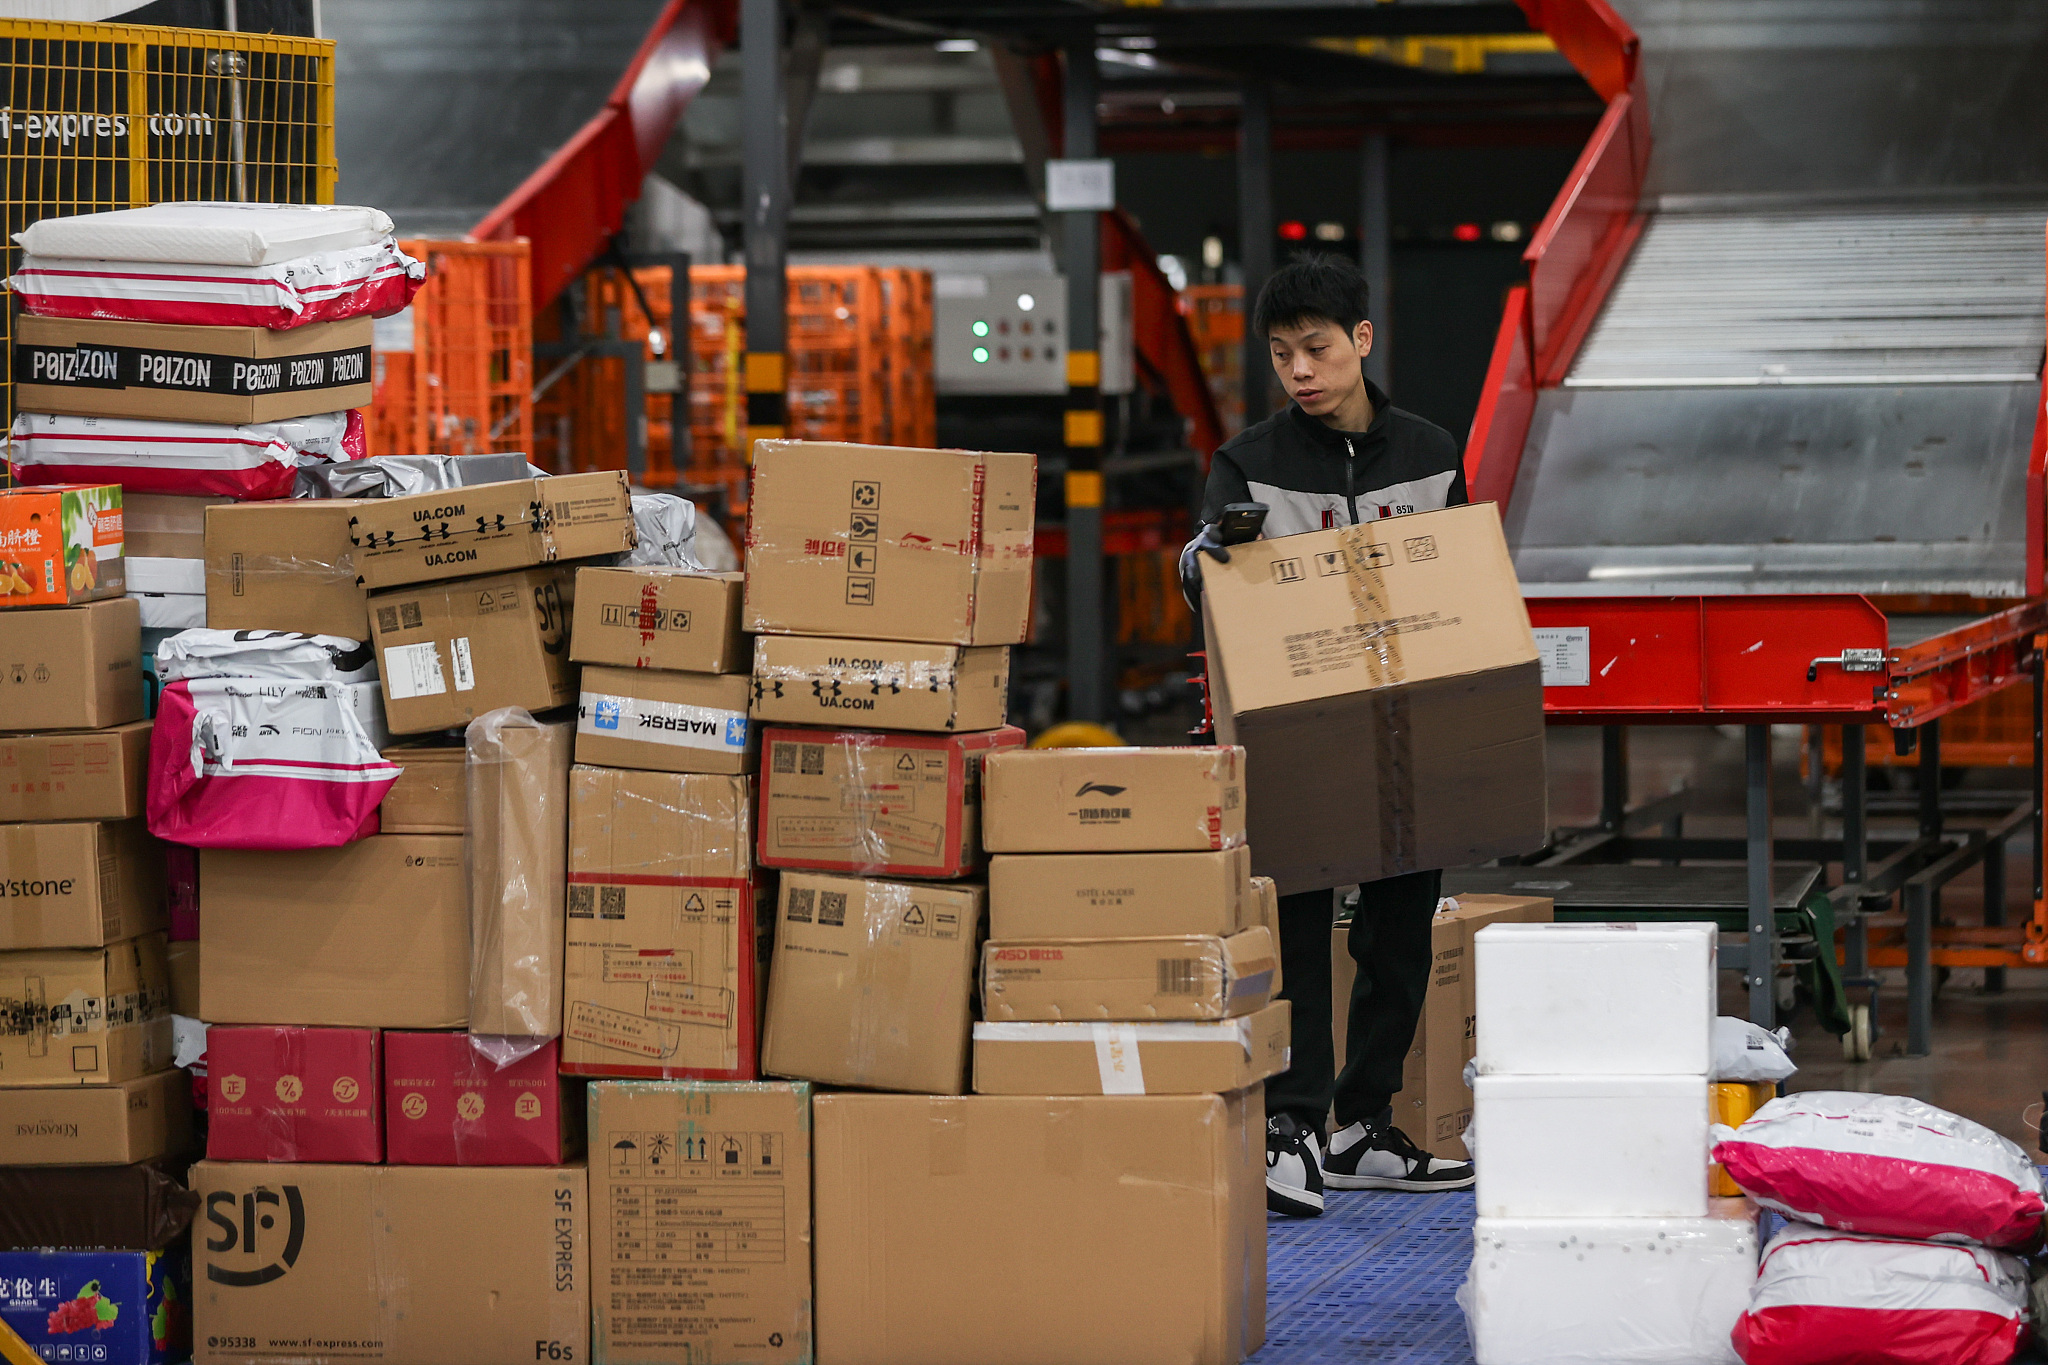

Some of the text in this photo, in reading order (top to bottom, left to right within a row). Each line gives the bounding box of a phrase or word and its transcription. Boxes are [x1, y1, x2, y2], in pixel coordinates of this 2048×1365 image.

[413, 504, 466, 523] UA.COM
[424, 548, 478, 567] UA.COM
[828, 657, 883, 671] UA.COM
[259, 686, 287, 698] LILY
[819, 696, 875, 710] UA.COM
[639, 713, 717, 736] MAERSK
[994, 949, 1027, 961] ASD
[206, 1190, 280, 1254] SF
[554, 1188, 573, 1292] SF EXPRESS
[220, 1336, 384, 1349] 95338 www.sf-express.com
[535, 1340, 573, 1361] F6s
